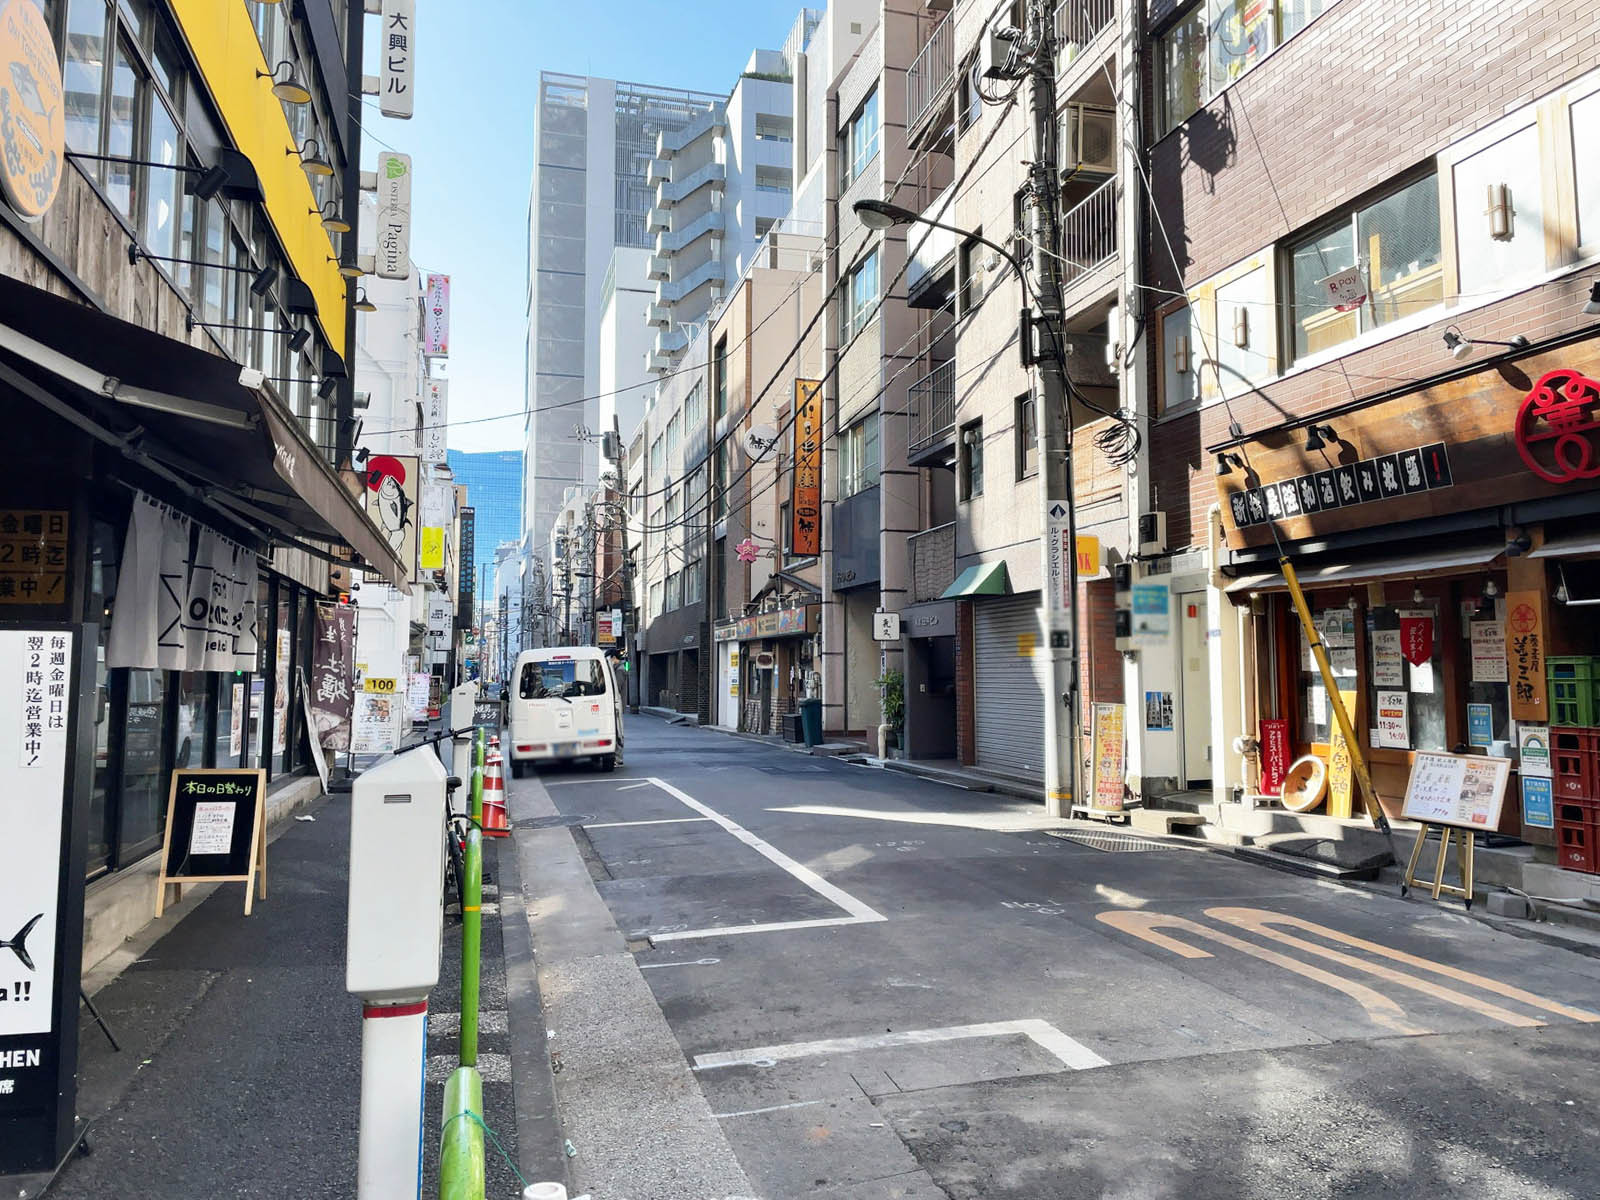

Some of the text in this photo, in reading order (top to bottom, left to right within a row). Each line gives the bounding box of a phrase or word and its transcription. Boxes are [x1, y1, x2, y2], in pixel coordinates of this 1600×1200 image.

[388, 13, 408, 94] 大興ビル
[383, 181, 402, 273] OSTERIA Pagina
[48, 636, 65, 729] 毎週金曜日は
[372, 680, 394, 690] 100
[182, 780, 252, 797] 本日の日替わり
